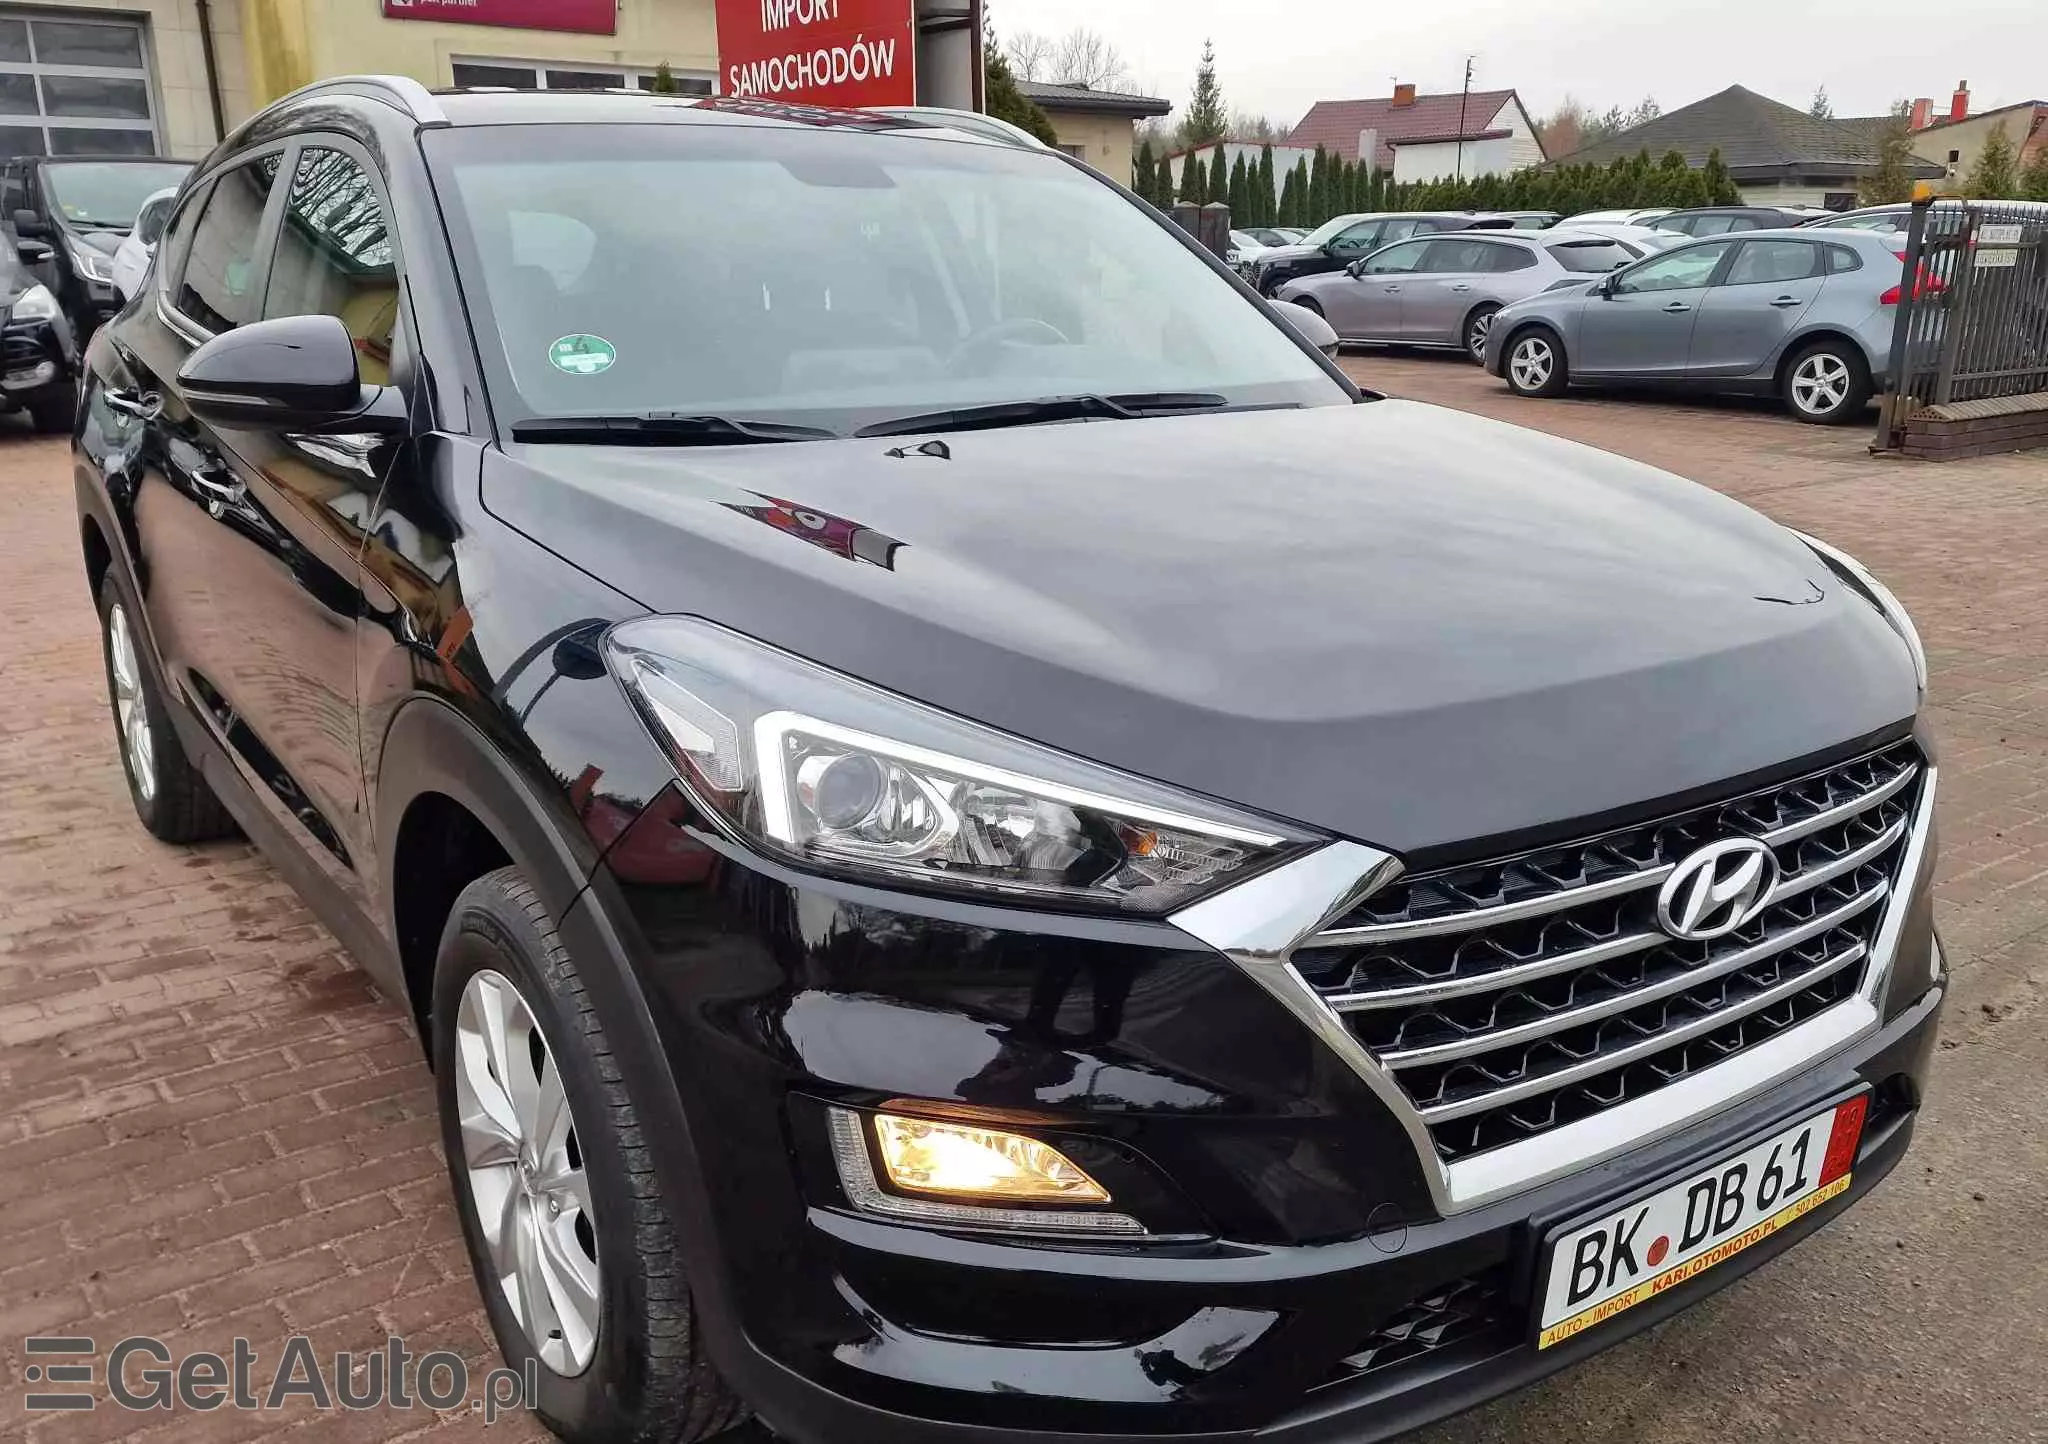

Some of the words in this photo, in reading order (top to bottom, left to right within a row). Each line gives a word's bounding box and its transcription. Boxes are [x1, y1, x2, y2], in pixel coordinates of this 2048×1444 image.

[730, 34, 896, 99] SAMOCHODÓW
[1567, 1206, 1650, 1307] BK
[1678, 1163, 1749, 1254] DB
[1757, 1128, 1812, 1212] 61
[1547, 1318, 1583, 1344] AUTO
[1593, 1290, 1640, 1322] IMPORT
[1651, 1219, 1777, 1294] KARI.OTOMOTO.PL
